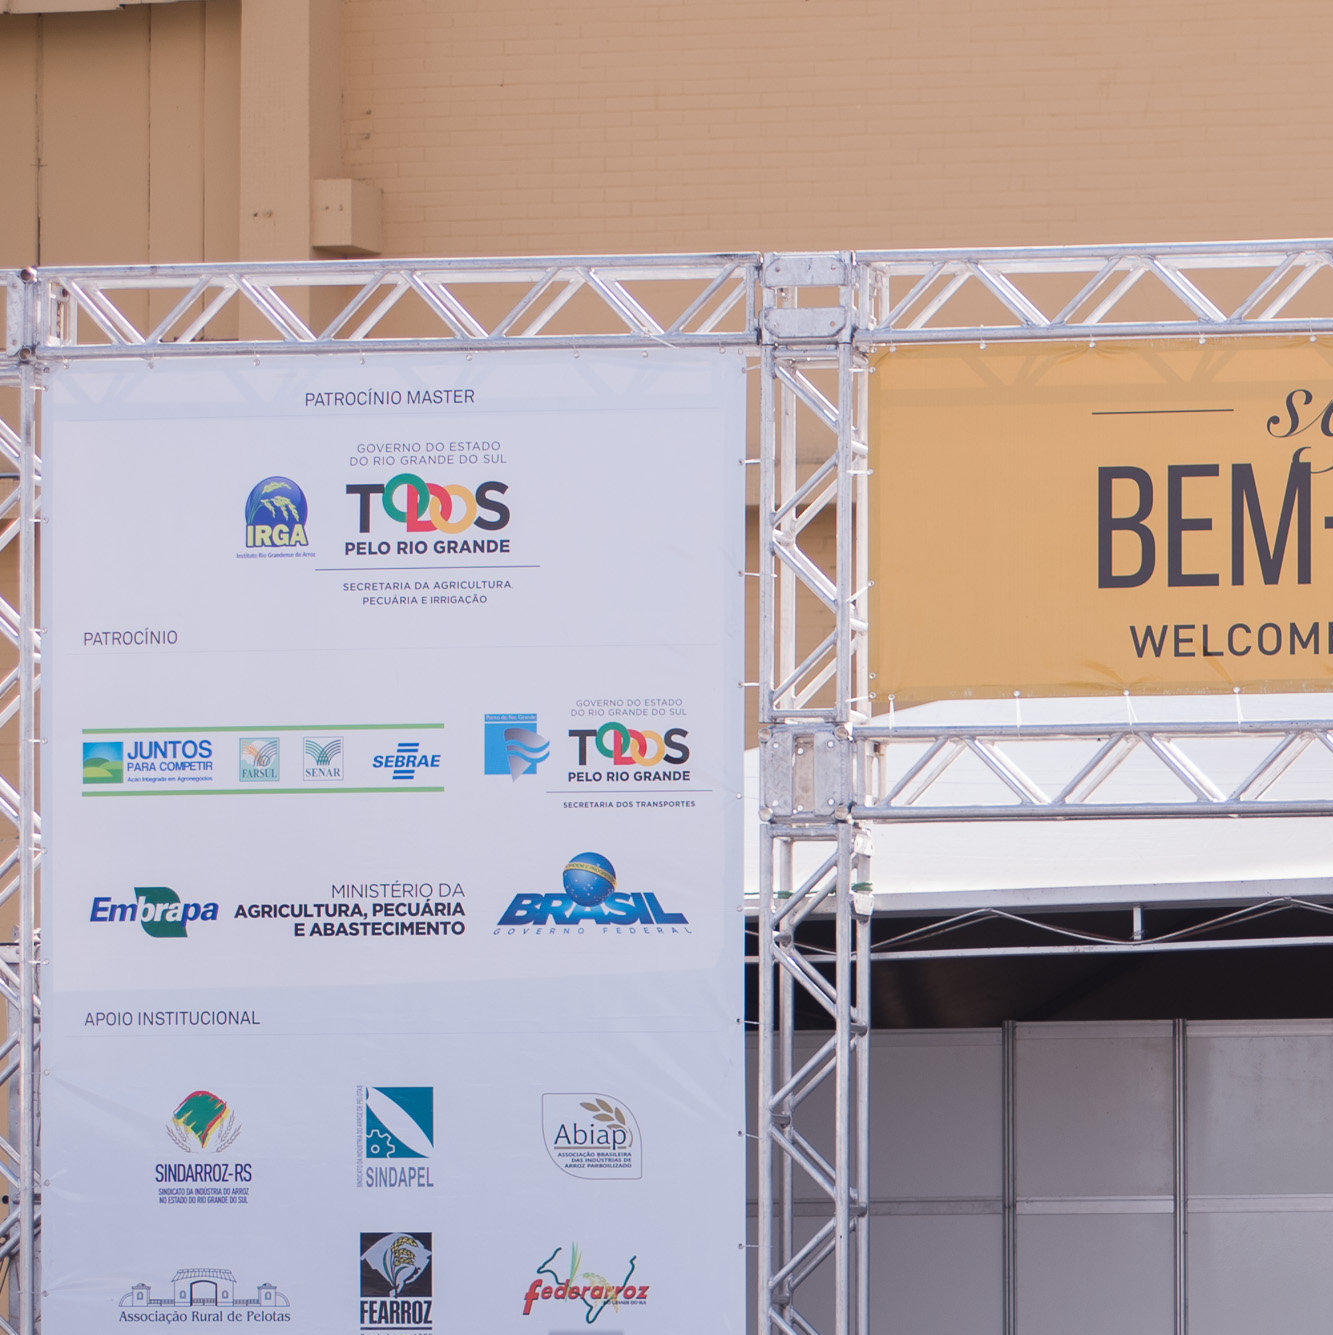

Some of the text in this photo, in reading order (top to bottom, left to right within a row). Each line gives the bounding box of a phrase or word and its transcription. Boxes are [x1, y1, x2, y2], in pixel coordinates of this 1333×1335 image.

[304, 387, 475, 407] PATROCÍNIO MASTER
[356, 440, 501, 454] GOVERNO DO ESTADO
[349, 453, 507, 467] DO RIO GRANDE DO SUL
[345, 472, 511, 535] TODOS
[246, 523, 309, 548] IRGA
[344, 538, 511, 556] PELO RIO GRANDE
[342, 581, 412, 592] SECRETARIA
[413, 581, 431, 591] DA
[362, 593, 488, 606] PECUÁRIA E IRRIGAÇÃO
[83, 627, 178, 647] PATROCÍNIO
[575, 698, 683, 708] GOVERNO DO ESTADO
[570, 707, 688, 717] DO RIO GRANDE DO SUL
[126, 739, 213, 760] JUNTOS
[568, 721, 690, 768] TODOS
[127, 760, 213, 772] PARA COMPETIR
[372, 754, 442, 769] SEBRAE
[241, 768, 278, 779] FARSUL
[305, 767, 341, 778] SENAR
[567, 770, 691, 783] PELO RIO GRANDE
[562, 800, 696, 809] SECRETARIA DOS TRANSPORTES
[331, 880, 466, 899] MINISTÉRIO DA
[89, 895, 220, 929] Embrapa
[233, 901, 466, 921] AGRICULTURA, PECUÁRIA
[496, 891, 690, 926] BRASIL
[293, 922, 466, 937] E ABASTECIMENTO
[493, 926, 693, 936] GOVERNO FEDERAL
[84, 1010, 261, 1027] APOIO INSTITUCIONAL
[553, 1122, 628, 1151] Abiap
[154, 1162, 253, 1183] SINDARROZ-RS
[365, 1166, 435, 1188] SINDAPEL
[522, 1278, 650, 1316] federarroz
[118, 1310, 291, 1325] Associação Rural de Pelotas
[359, 1299, 433, 1325] FEARROZ
